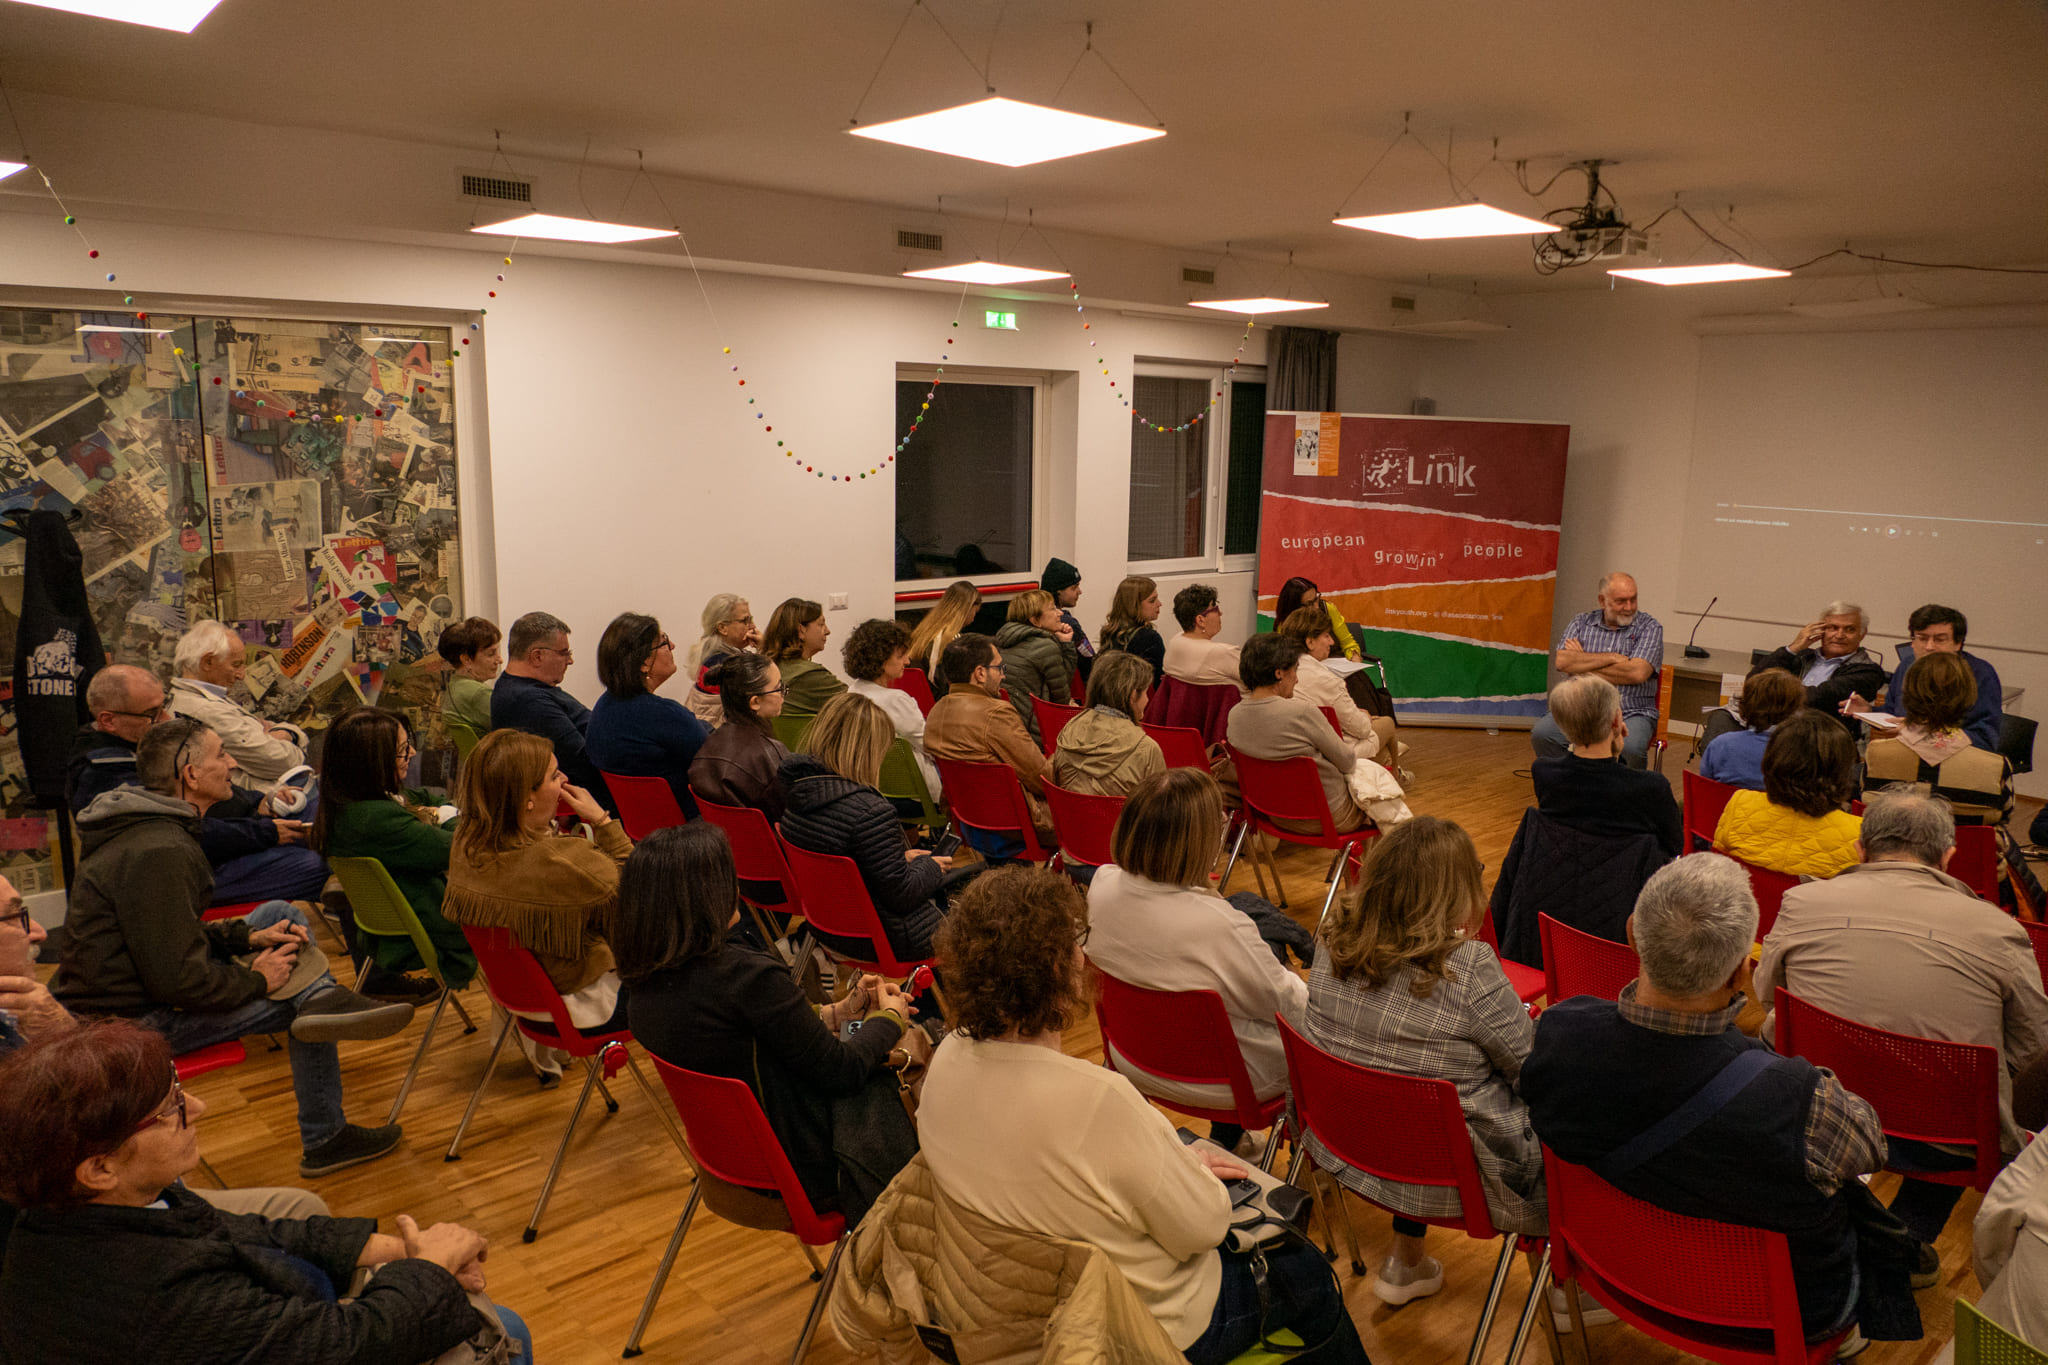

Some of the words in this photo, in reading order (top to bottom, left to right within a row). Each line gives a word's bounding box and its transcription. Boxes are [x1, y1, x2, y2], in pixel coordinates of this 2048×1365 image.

[1407, 454, 1476, 487] Link
[1281, 533, 1365, 550] european
[1374, 550, 1444, 567] growin'
[1463, 543, 1523, 558] people
[280, 627, 326, 669] ROBINSON
